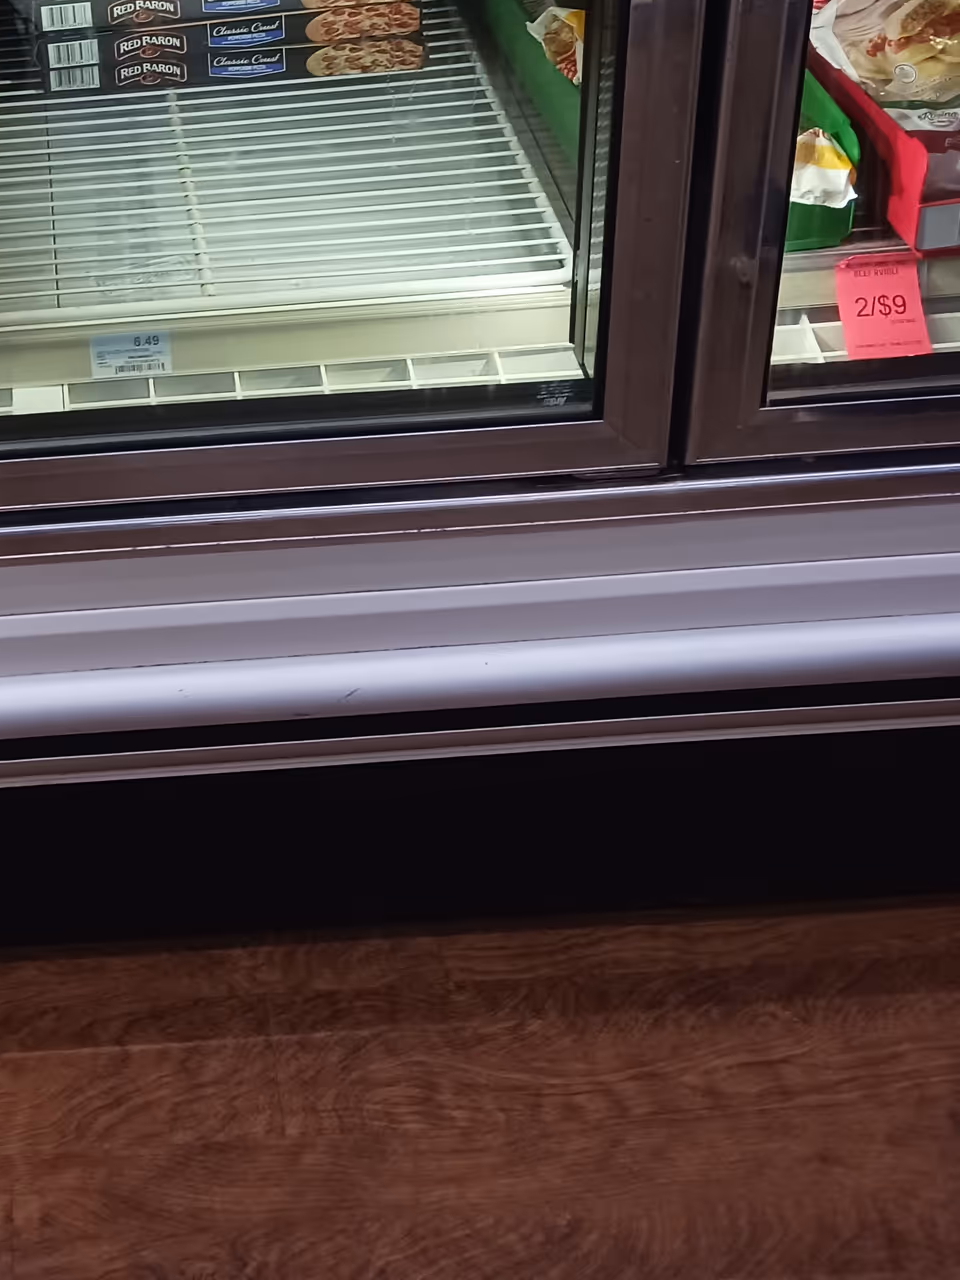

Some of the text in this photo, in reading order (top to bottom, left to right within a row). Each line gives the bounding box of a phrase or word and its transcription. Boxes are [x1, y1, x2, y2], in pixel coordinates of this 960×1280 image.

[213, 53, 281, 66] Classic Crust
[120, 63, 180, 79] RED BARON
[854, 294, 907, 318] 2/$9
[134, 334, 159, 347] 6.49
